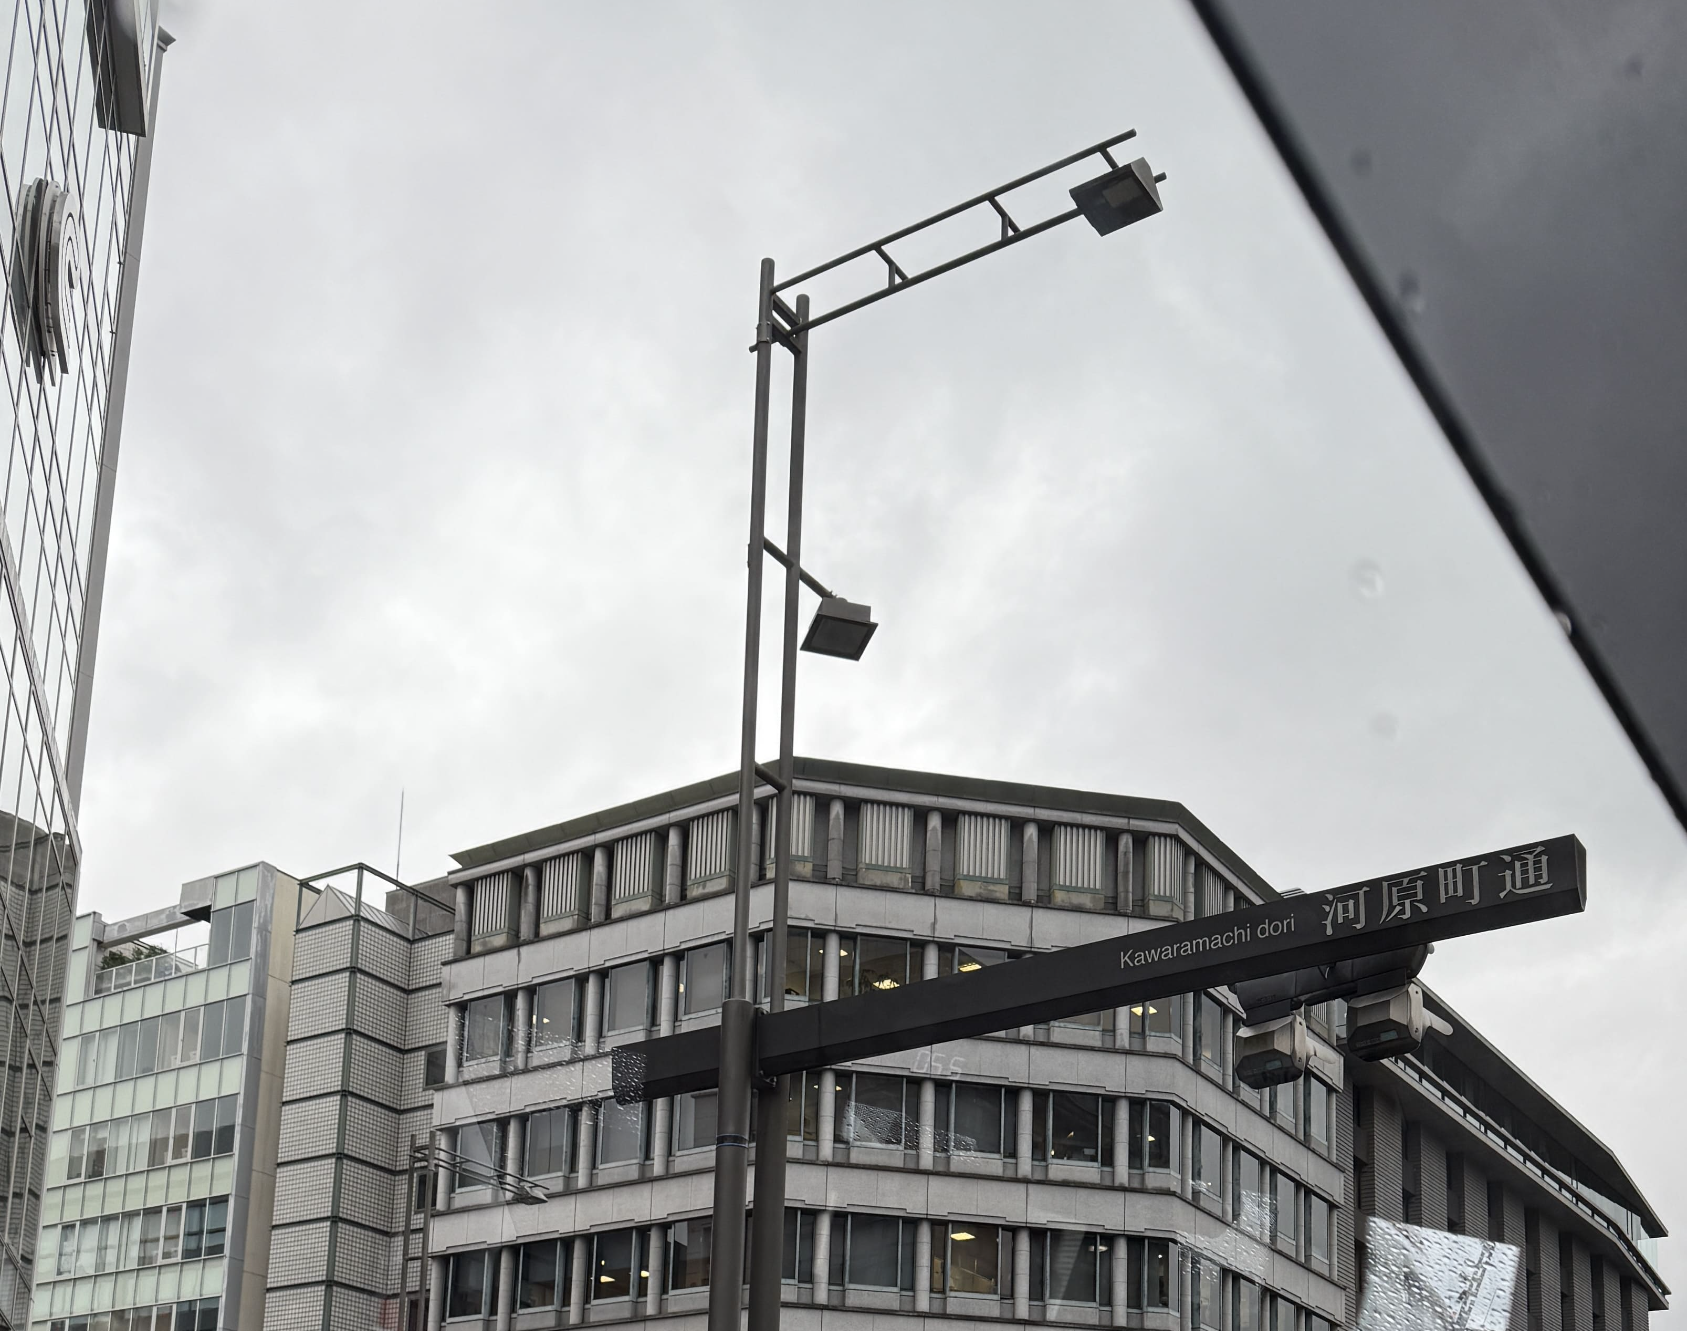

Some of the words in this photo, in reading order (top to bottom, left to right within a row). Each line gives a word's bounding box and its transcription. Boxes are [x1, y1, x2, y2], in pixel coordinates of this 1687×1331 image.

[1322, 845, 1553, 937] 河原町通
[1119, 923, 1251, 970] Kawaramachi
[1257, 914, 1296, 939] dori
